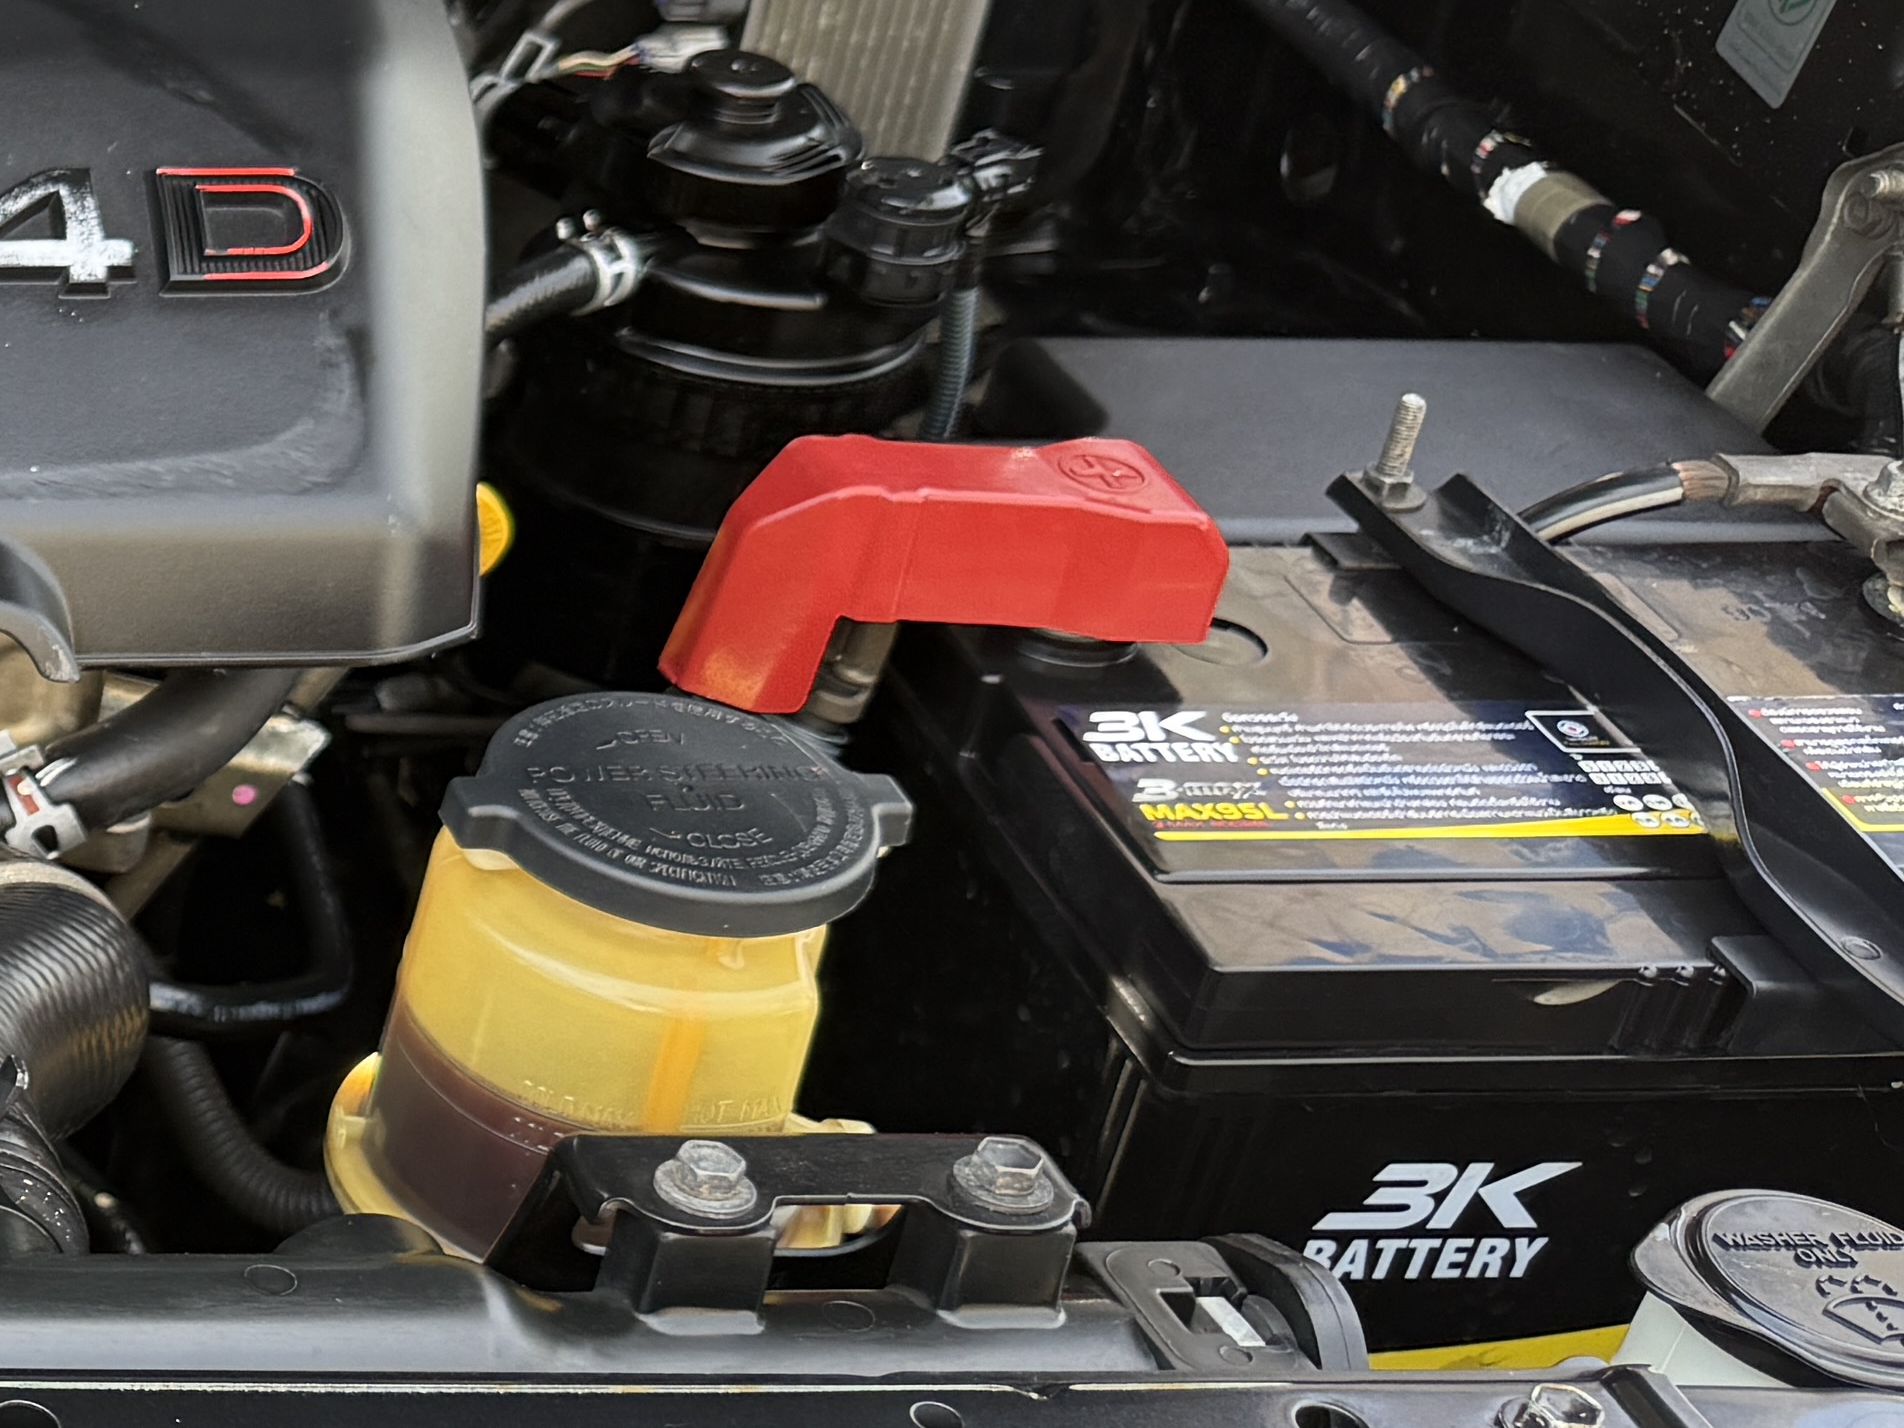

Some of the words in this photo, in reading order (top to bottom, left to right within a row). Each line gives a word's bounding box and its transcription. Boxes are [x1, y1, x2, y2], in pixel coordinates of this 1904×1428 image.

[1082, 710, 1217, 742] 3K
[616, 728, 685, 746] OPEN
[1089, 742, 1238, 763] BATTERY
[526, 766, 652, 784] POWER
[658, 762, 826, 783] STEERING
[646, 794, 745, 812] FLUID
[1139, 802, 1289, 822] MAX95L
[573, 832, 608, 853] FLUID
[686, 827, 774, 849] CLOSE
[1311, 1161, 1583, 1231] 3K
[1711, 1231, 1829, 1252] WASHER
[1829, 1231, 1904, 1252] FLUID
[1302, 1236, 1549, 1280] BATTERY
[1793, 1247, 1859, 1268] ONLY
